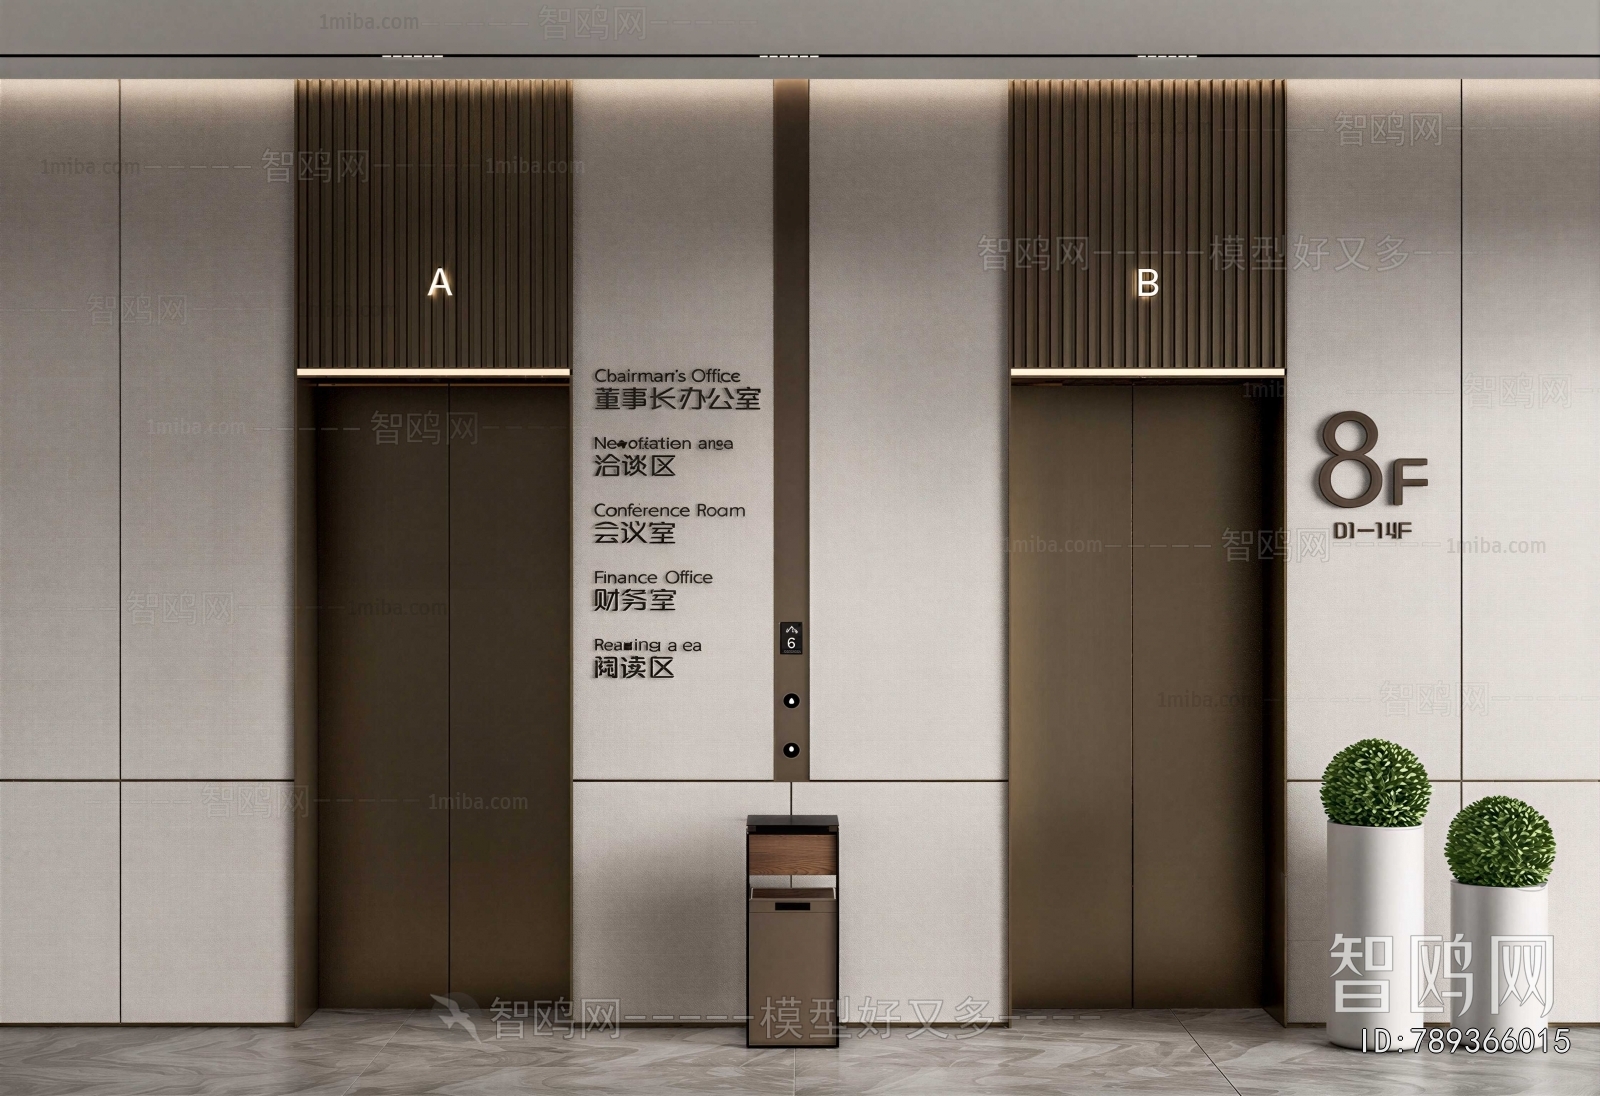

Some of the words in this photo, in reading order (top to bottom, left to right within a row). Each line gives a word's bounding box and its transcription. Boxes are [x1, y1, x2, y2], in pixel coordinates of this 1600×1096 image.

[427, 268, 453, 296] A
[1138, 268, 1159, 297] B
[691, 368, 741, 383] Office
[594, 387, 761, 411] 董事长办公室
[594, 453, 676, 477] 洽谈区
[594, 502, 690, 518] Conference
[594, 521, 676, 544] 会议室
[594, 570, 658, 585] Finance
[665, 570, 714, 585] Office
[594, 588, 677, 612] 财务室
[787, 637, 796, 649] 6
